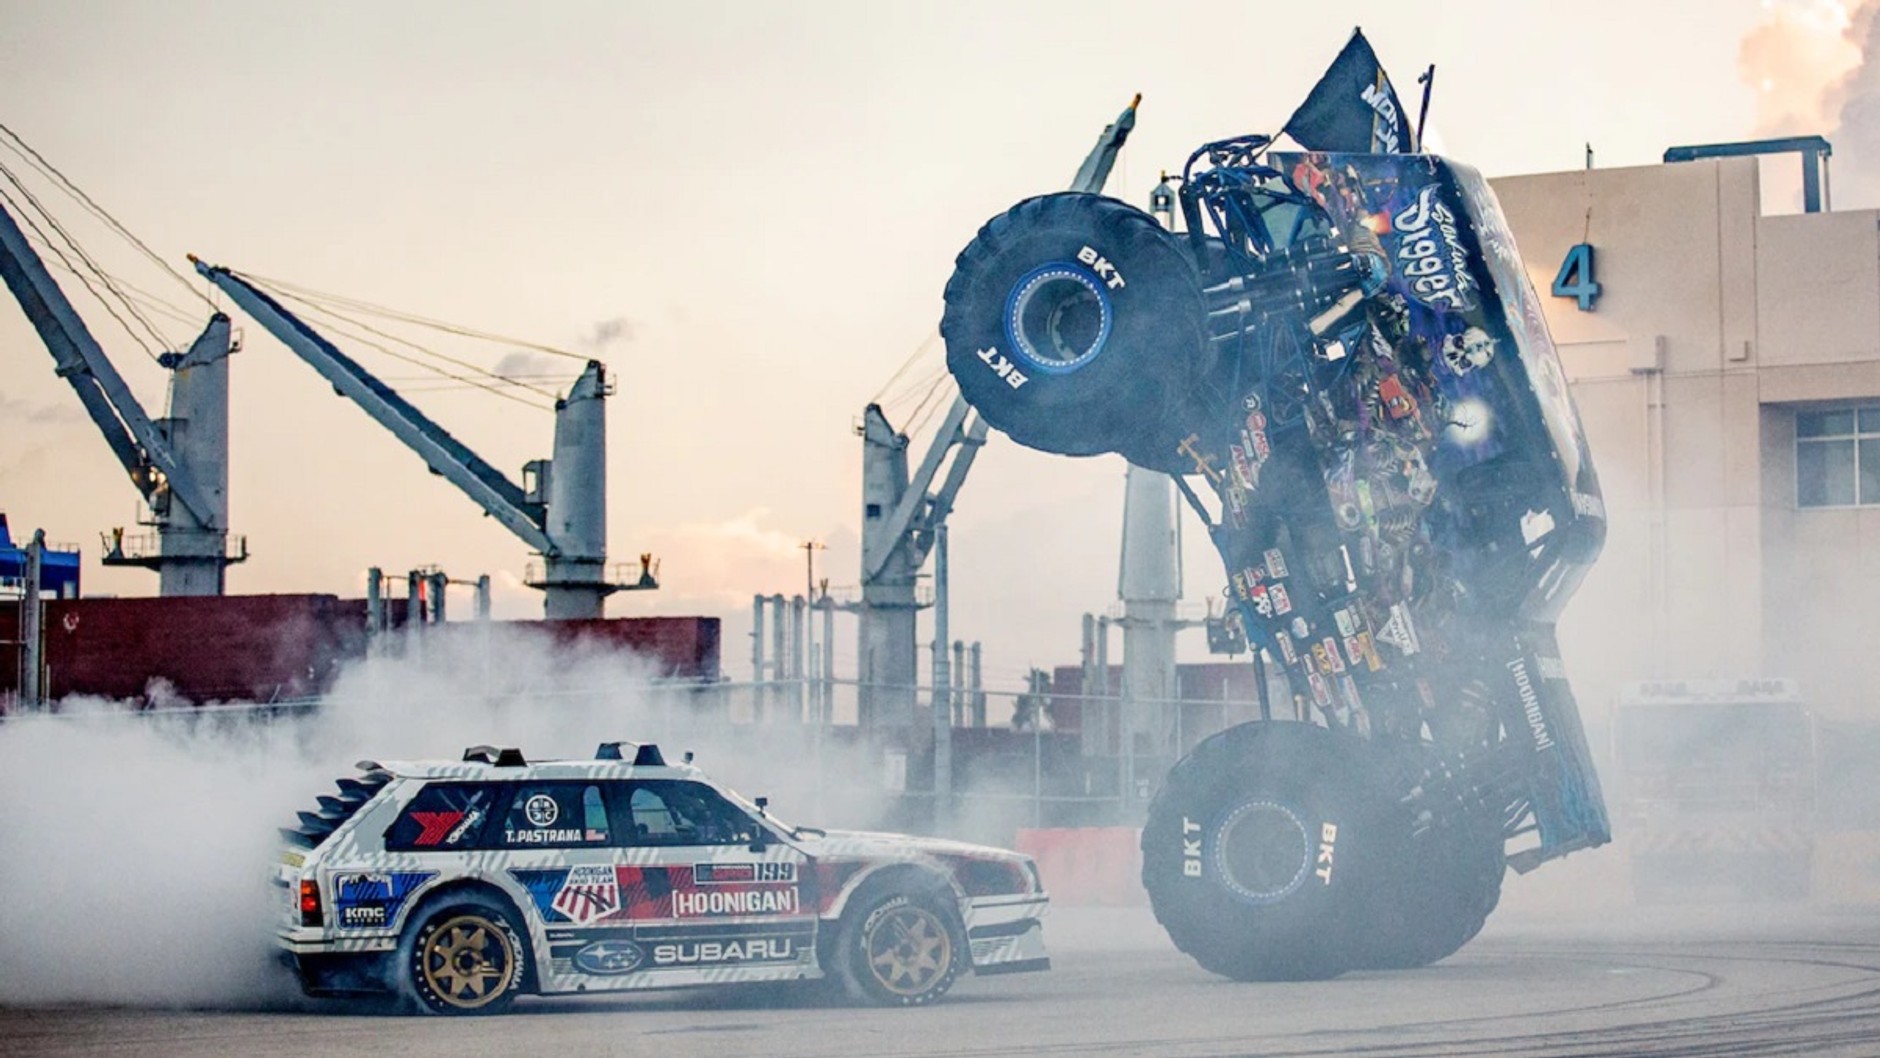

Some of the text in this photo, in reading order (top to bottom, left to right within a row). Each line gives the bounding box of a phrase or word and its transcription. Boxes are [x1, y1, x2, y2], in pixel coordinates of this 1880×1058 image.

[1077, 245, 1126, 290] BKT
[1393, 186, 1466, 313] Digger
[1552, 243, 1601, 311] 4
[976, 346, 1029, 390] BKT
[517, 829, 582, 843] PASTRANA
[1183, 816, 1202, 877] BKT
[1316, 822, 1337, 885] BKT
[757, 862, 793, 881] 199
[654, 939, 791, 963] SUBARU
